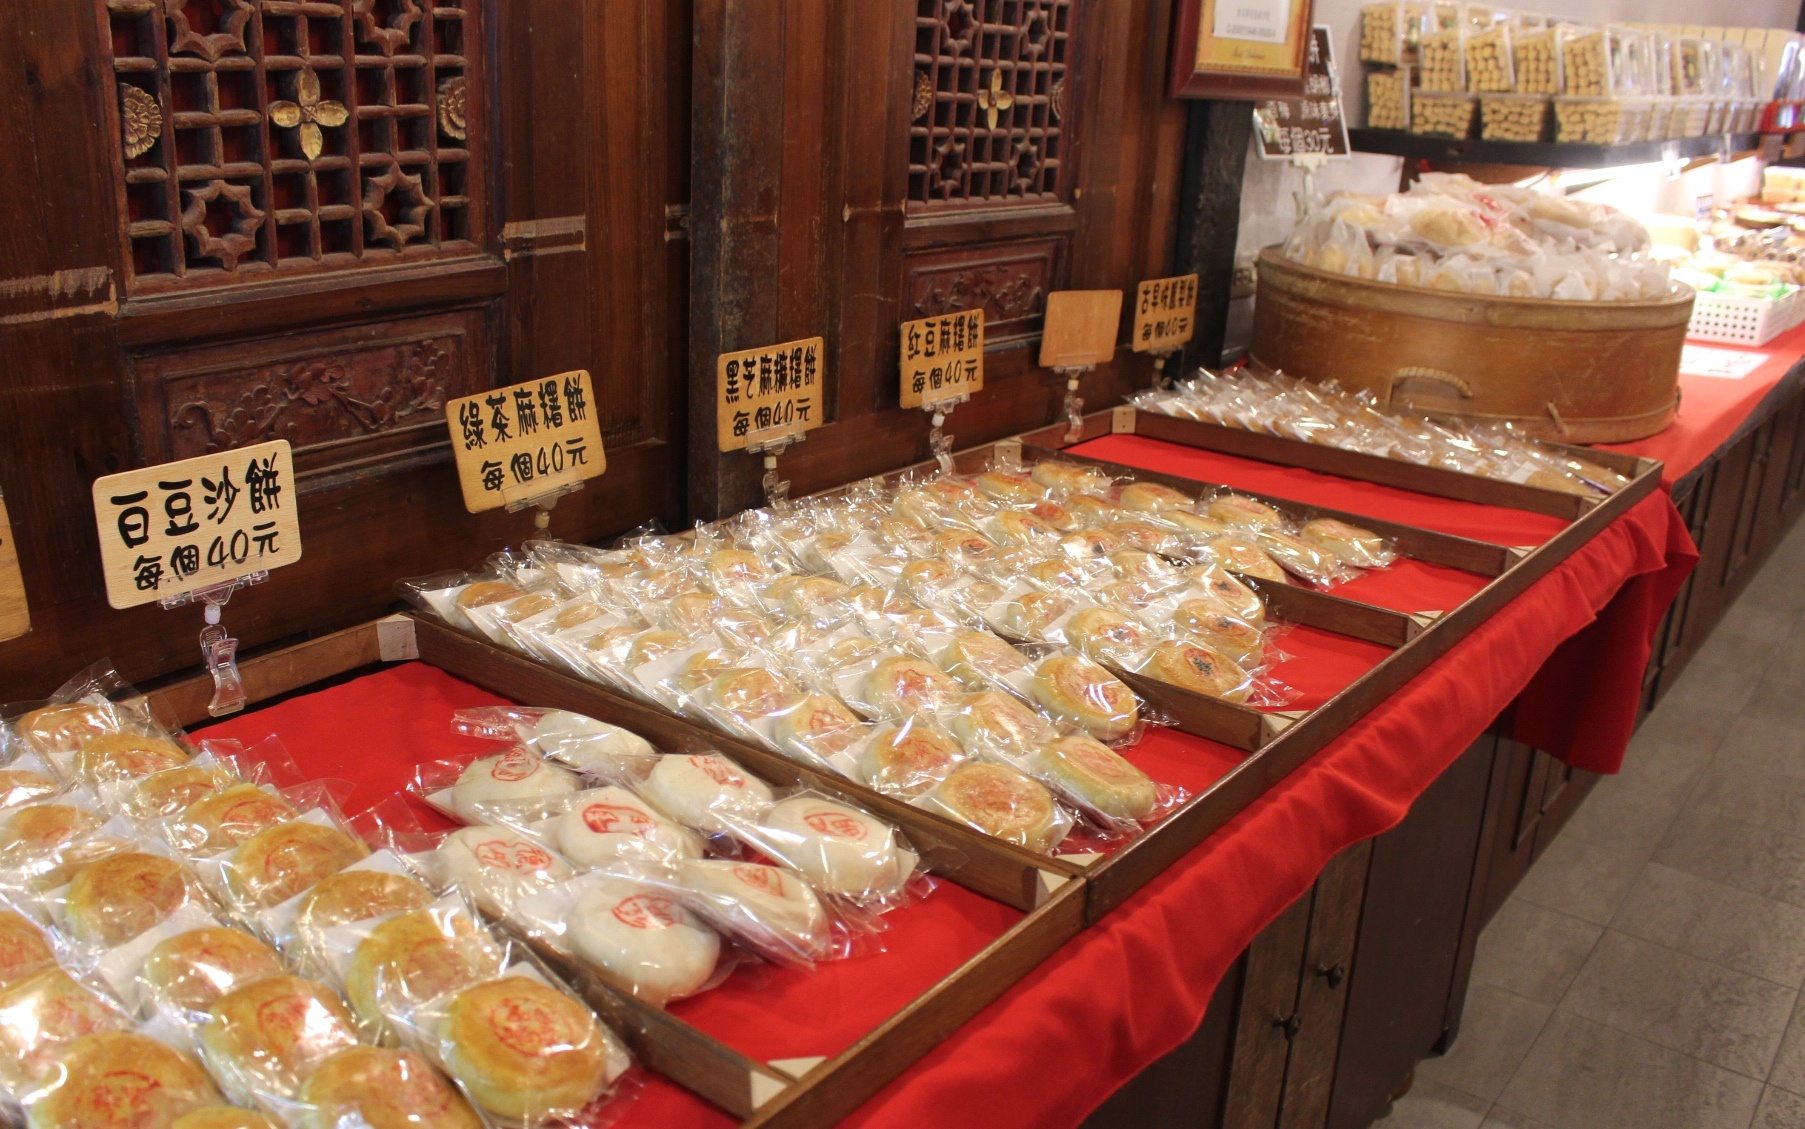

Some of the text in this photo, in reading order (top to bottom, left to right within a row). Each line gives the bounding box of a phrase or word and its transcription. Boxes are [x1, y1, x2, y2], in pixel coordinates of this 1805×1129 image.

[912, 358, 978, 394] 每個40元
[732, 397, 812, 437] 每個40元
[480, 436, 588, 492] 每個40元
[133, 520, 280, 591] 每個40元
